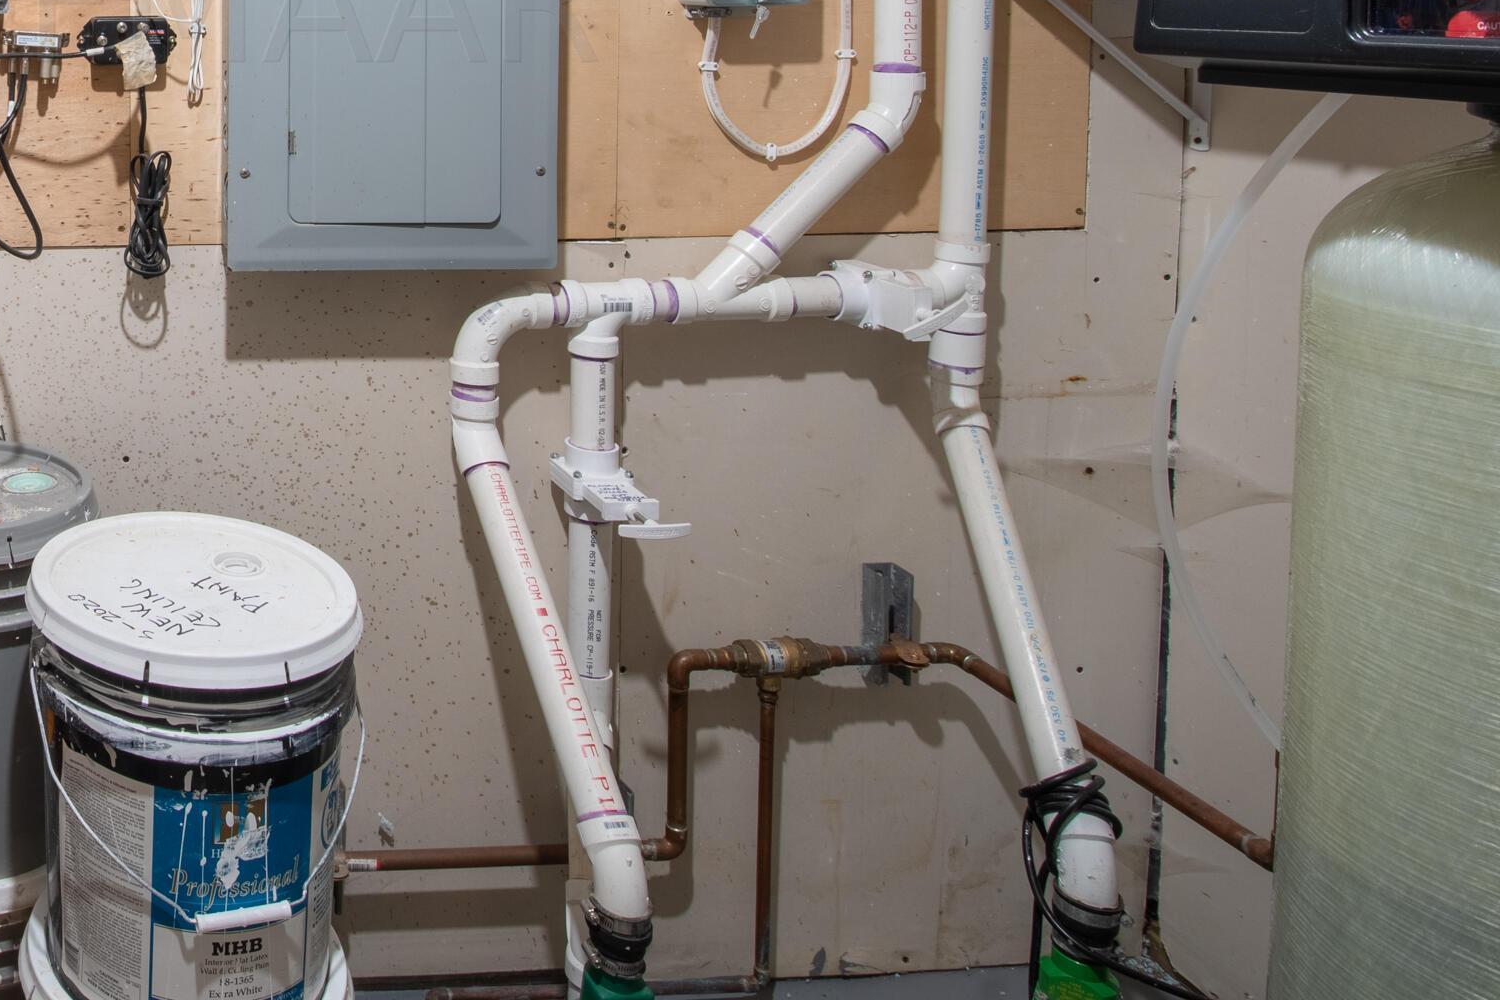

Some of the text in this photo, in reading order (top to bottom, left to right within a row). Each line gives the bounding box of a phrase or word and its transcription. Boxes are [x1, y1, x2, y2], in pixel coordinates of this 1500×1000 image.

[976, 168, 984, 190] ASTM
[598, 377, 606, 392] MADE
[191, 576, 269, 614] PAINT
[586, 529, 598, 641] Code ASTM 891-16 PRESSURE
[120, 578, 221, 628] CEILING
[121, 603, 195, 636] NEW
[540, 623, 599, 759] CHARLOTTE
[170, 853, 301, 912] Professional
[211, 937, 263, 956] MHB
[250, 953, 268, 963] Latex
[200, 966, 218, 975] Wall
[236, 985, 263, 996] White
